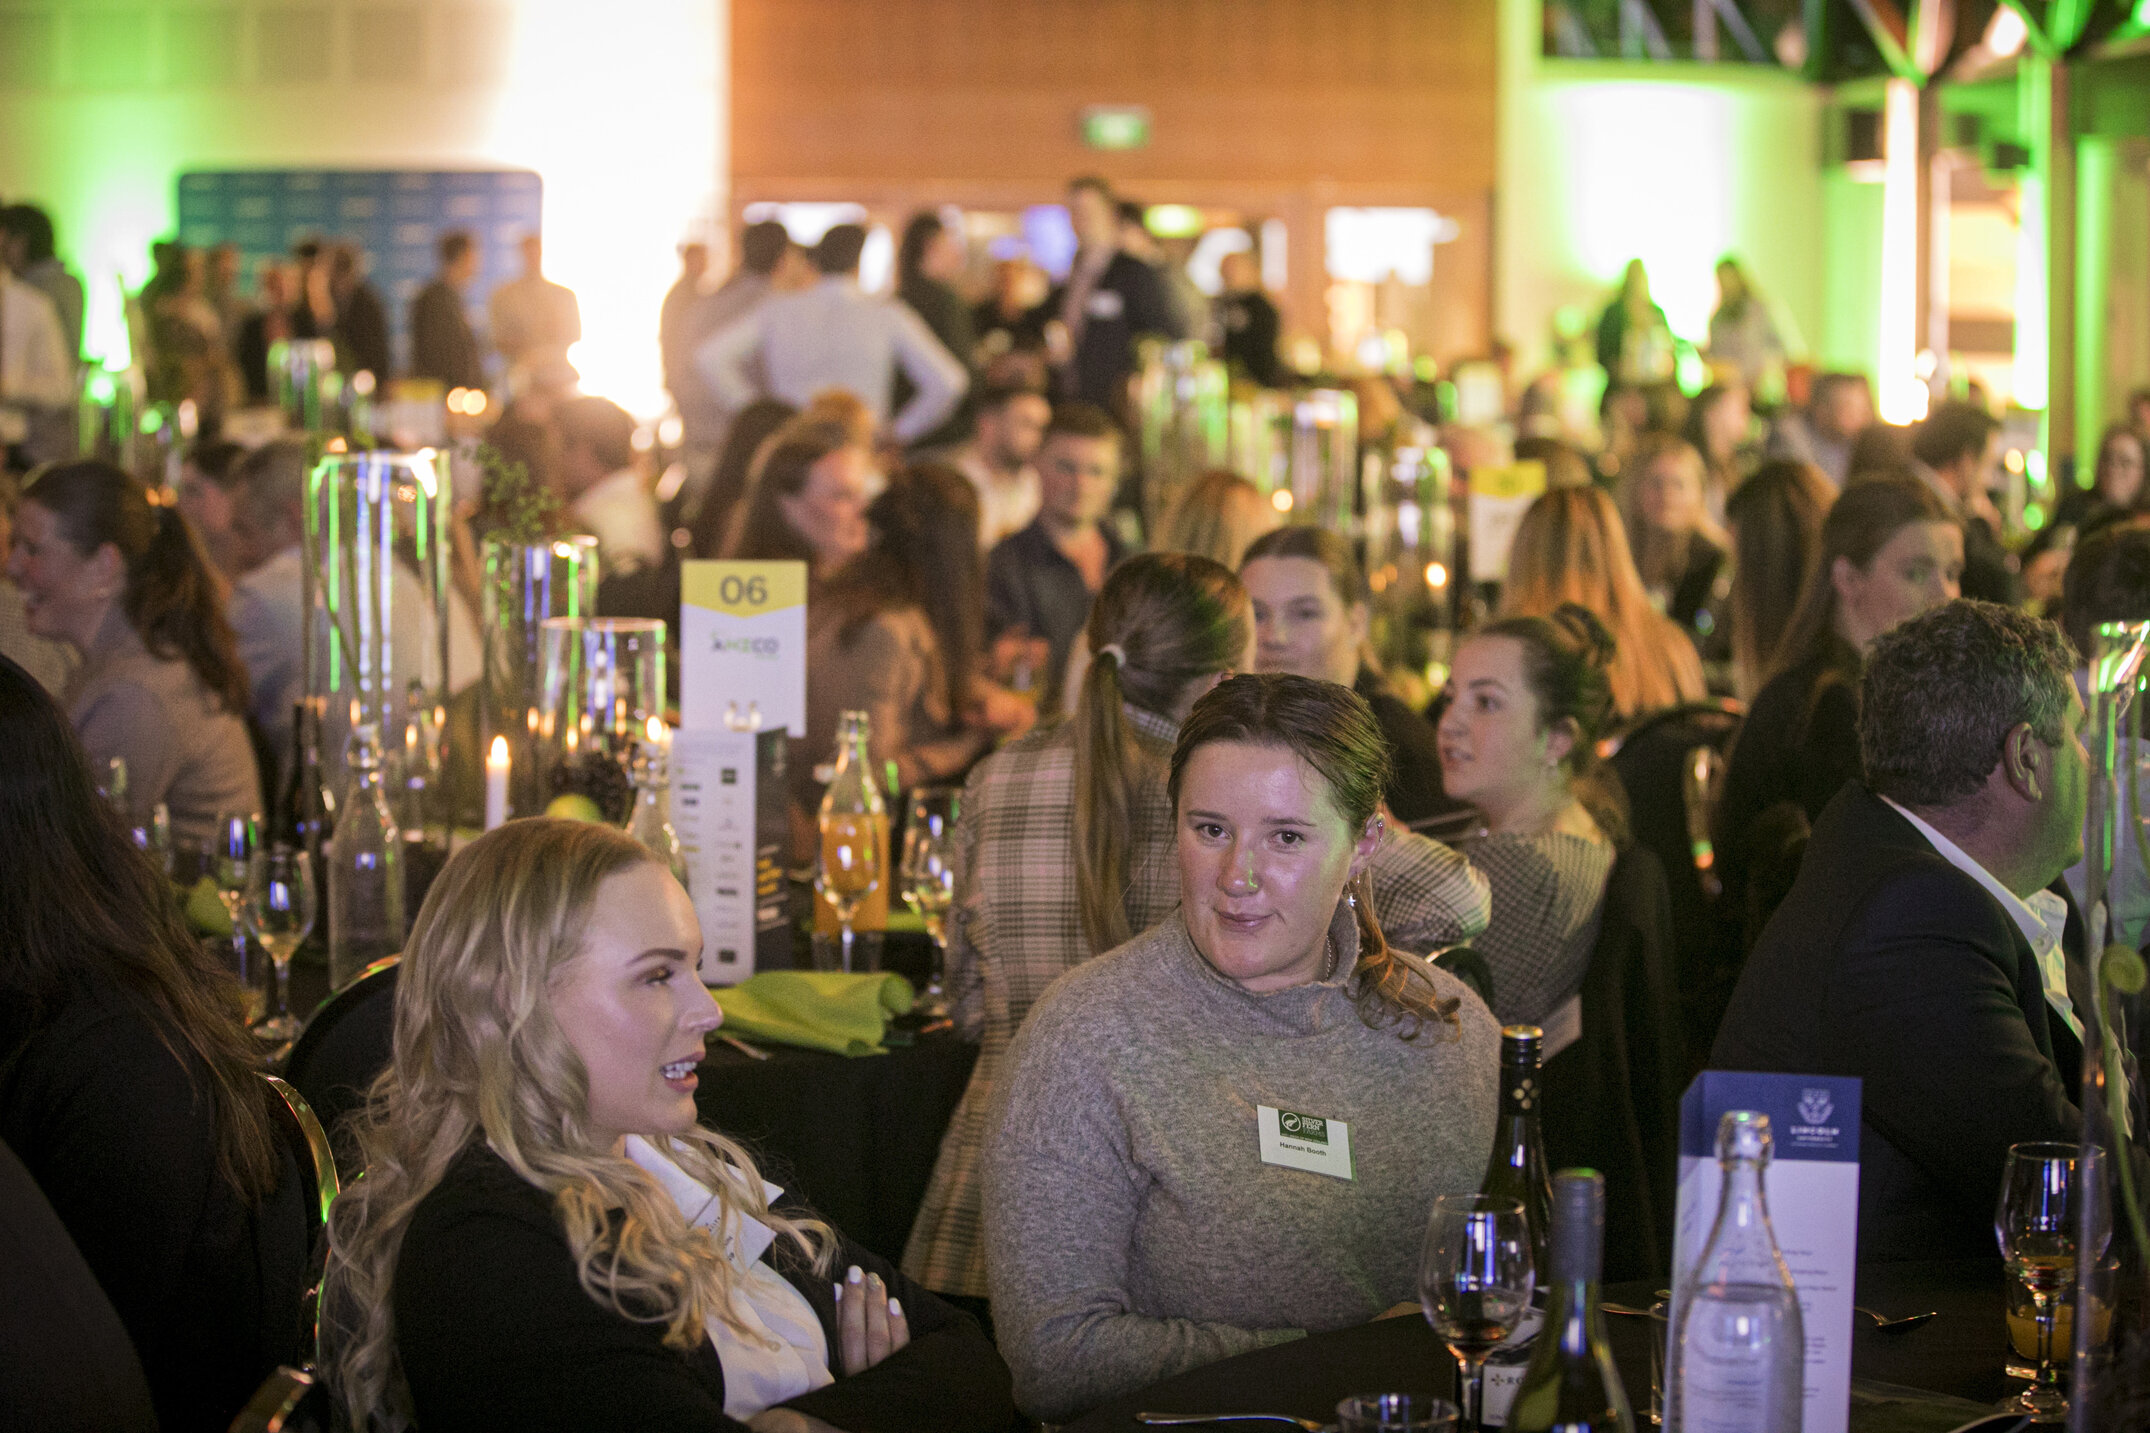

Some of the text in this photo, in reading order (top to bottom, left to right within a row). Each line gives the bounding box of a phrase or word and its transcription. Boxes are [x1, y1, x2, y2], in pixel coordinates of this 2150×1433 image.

[720, 575, 769, 605] 06
[1302, 1117, 1323, 1126] SILVER
[1302, 1122, 1319, 1130] FERN
[1279, 1142, 1326, 1155] Hannah Booth
